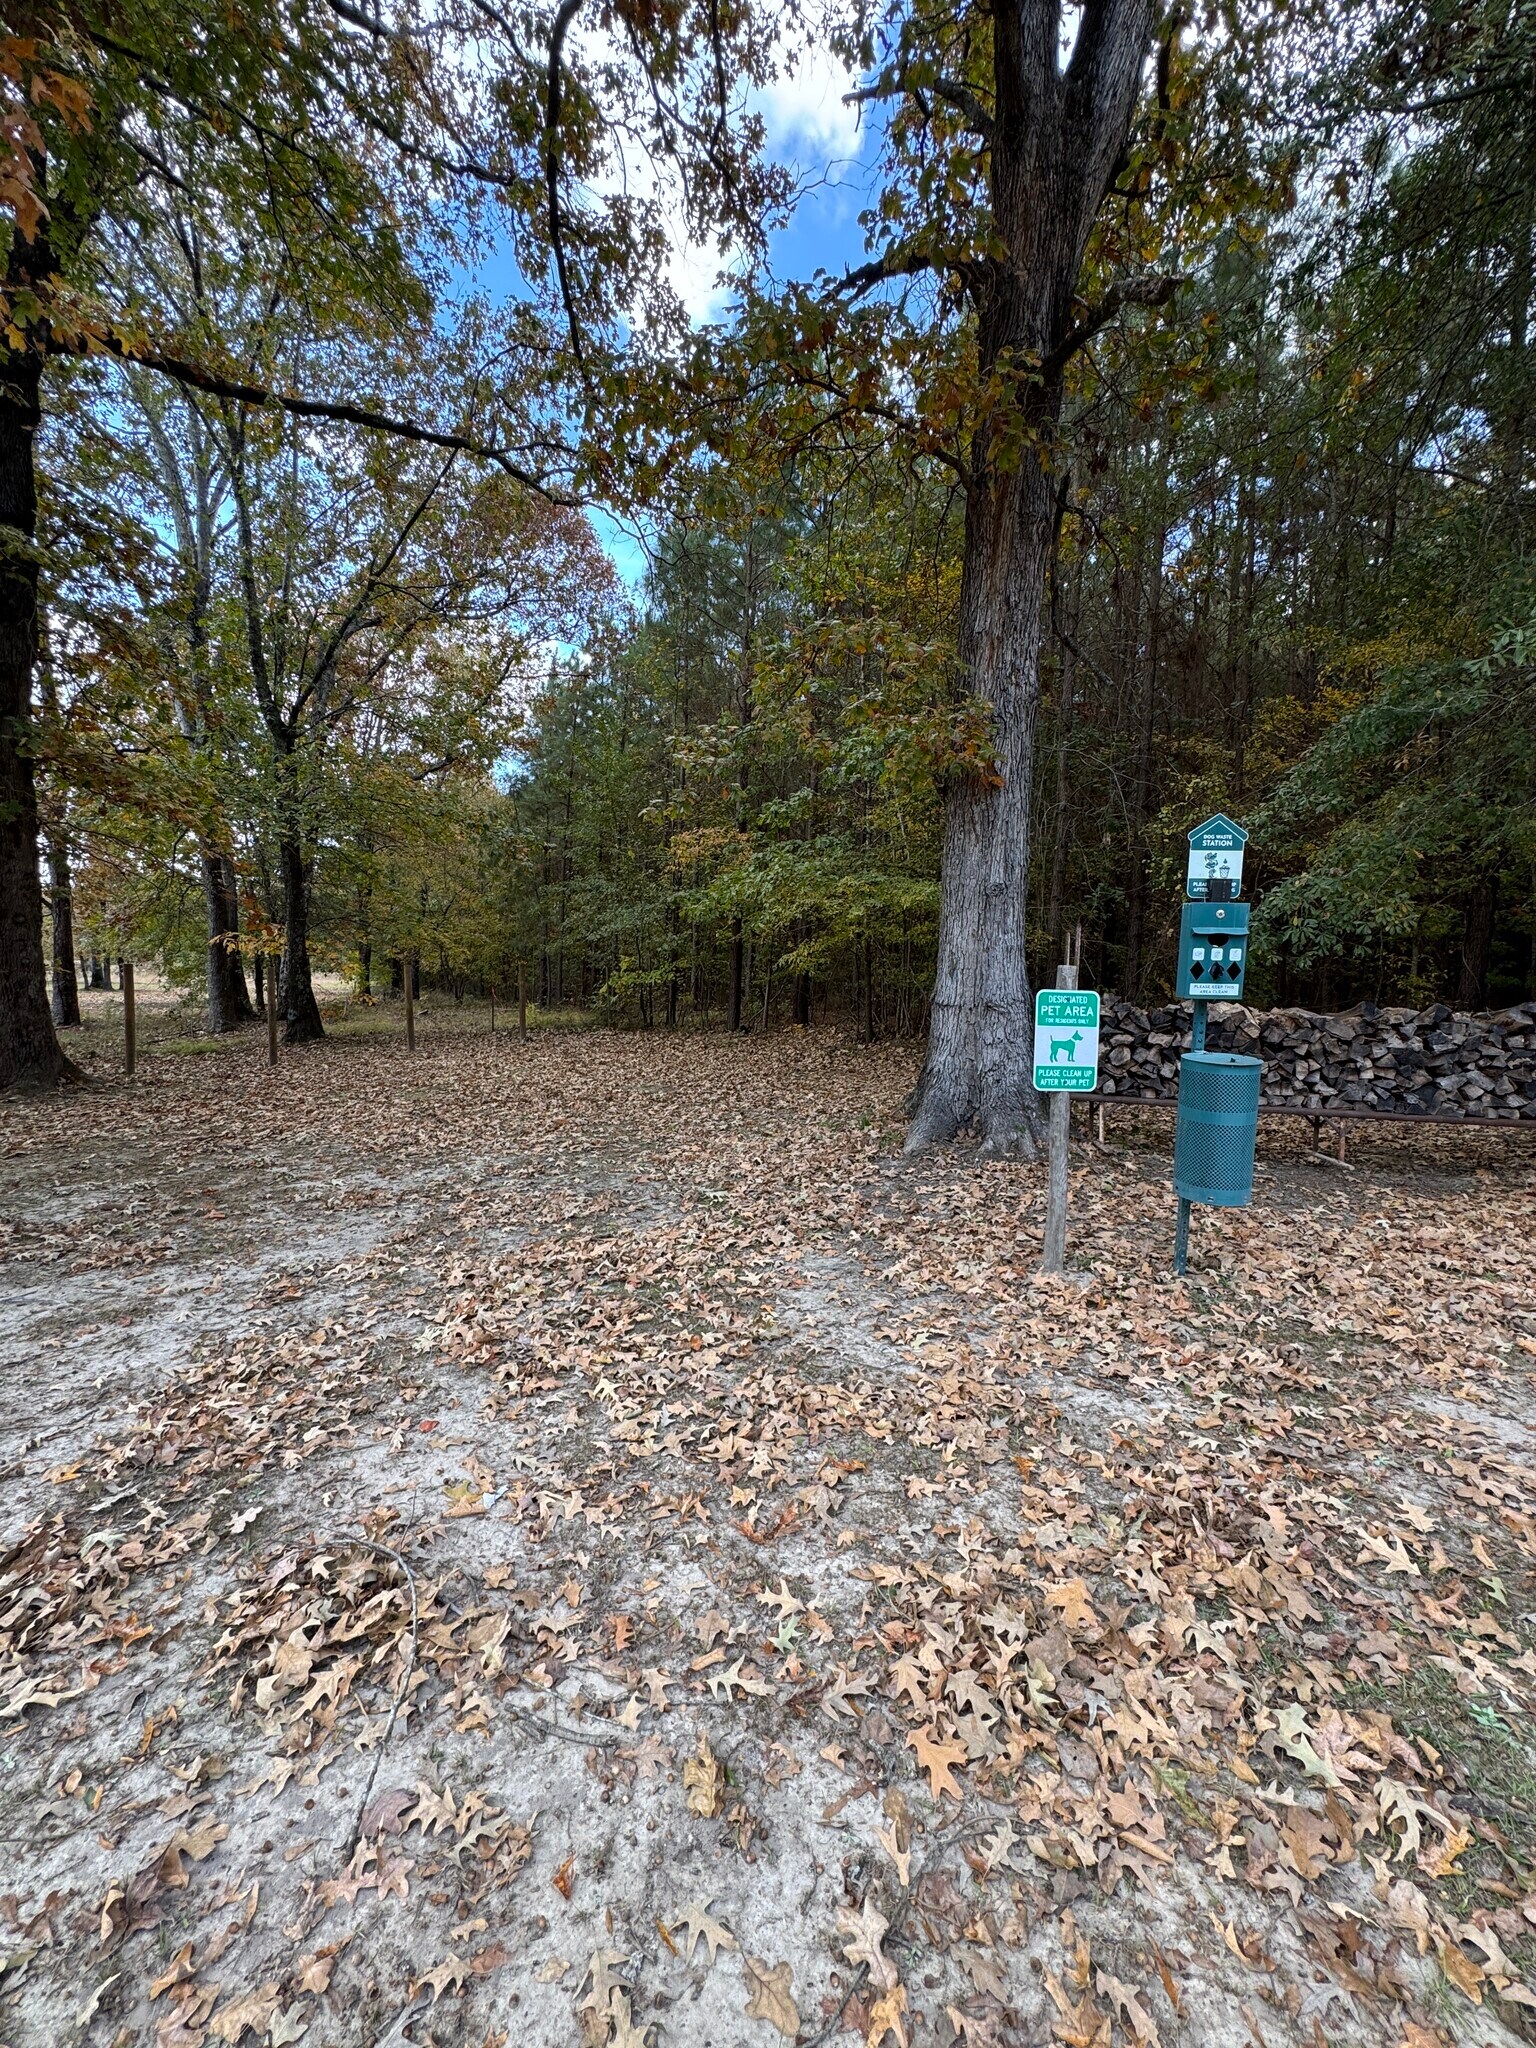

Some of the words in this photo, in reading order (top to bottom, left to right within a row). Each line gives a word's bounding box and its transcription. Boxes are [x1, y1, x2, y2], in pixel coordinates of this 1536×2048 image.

[1041, 1006, 1060, 1016] PET
[1064, 1006, 1094, 1016] AREA
[1062, 1070, 1082, 1078] CLEAN
